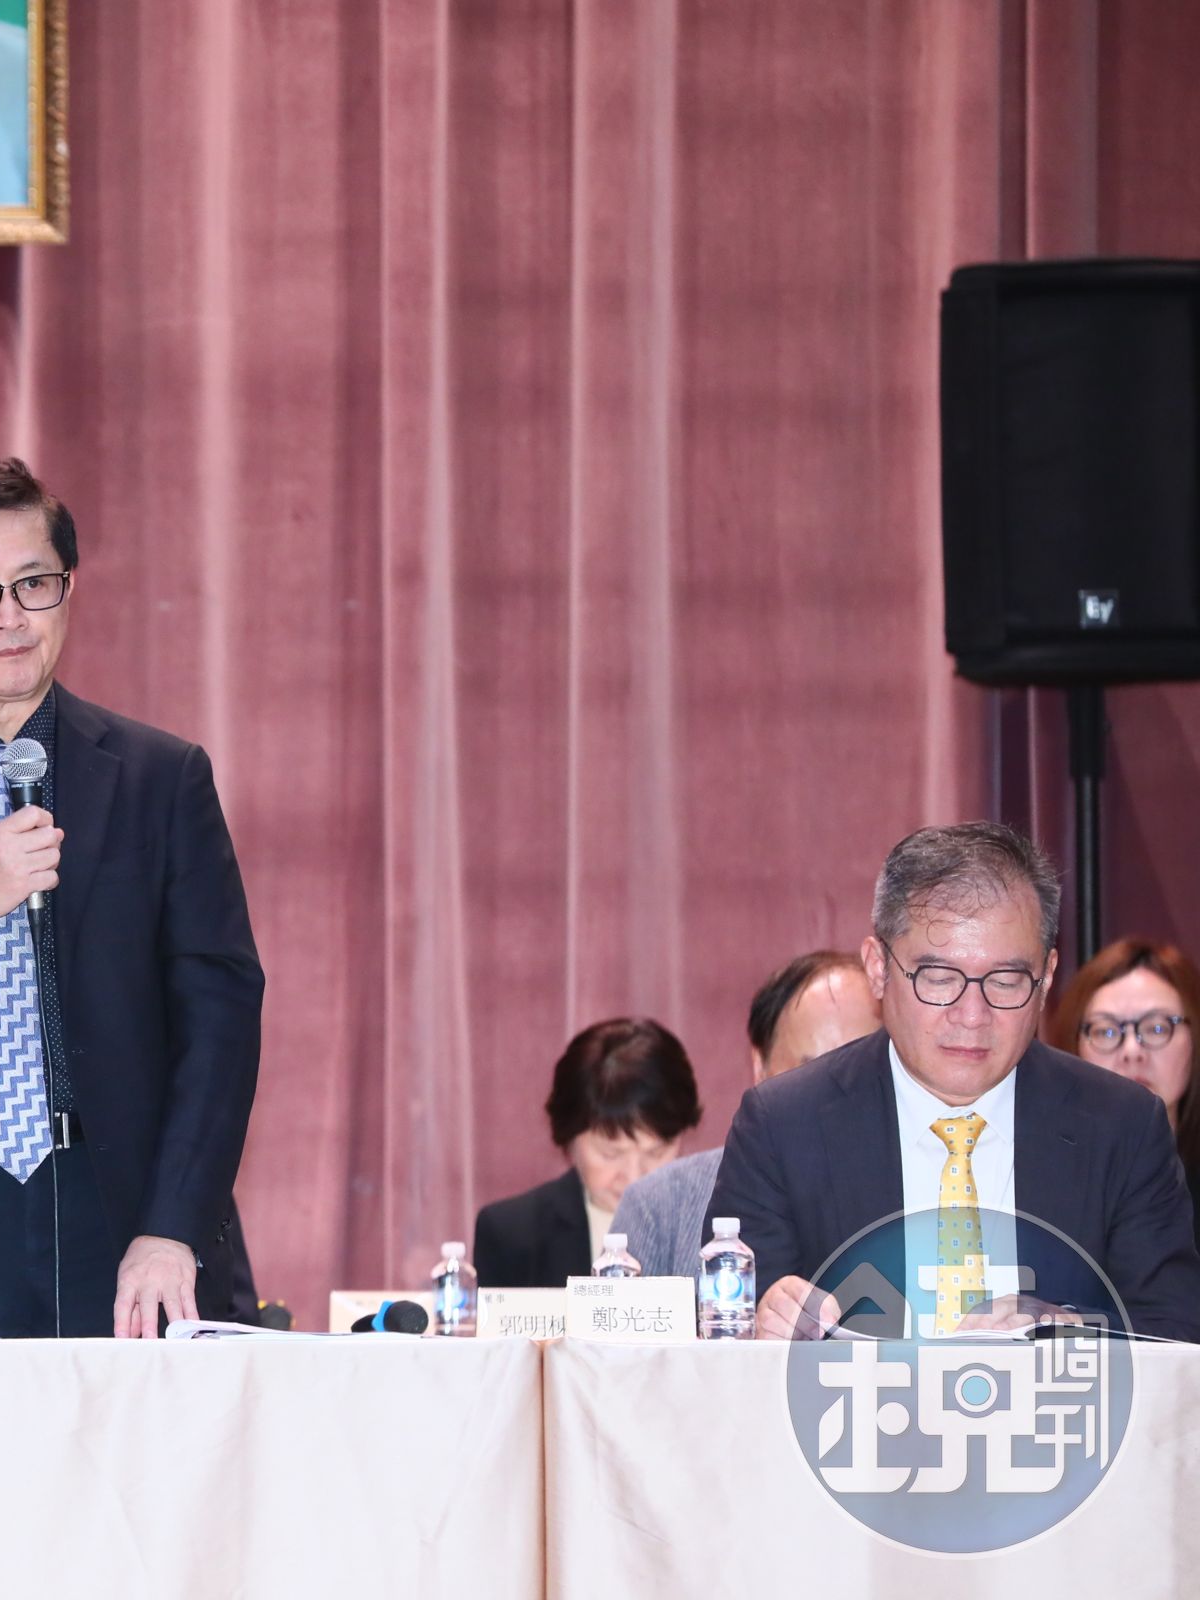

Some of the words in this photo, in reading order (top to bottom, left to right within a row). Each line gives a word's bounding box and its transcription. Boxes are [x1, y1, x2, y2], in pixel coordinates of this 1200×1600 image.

[573, 1284, 615, 1296] 總經理
[591, 1306, 673, 1332] 鄭光志
